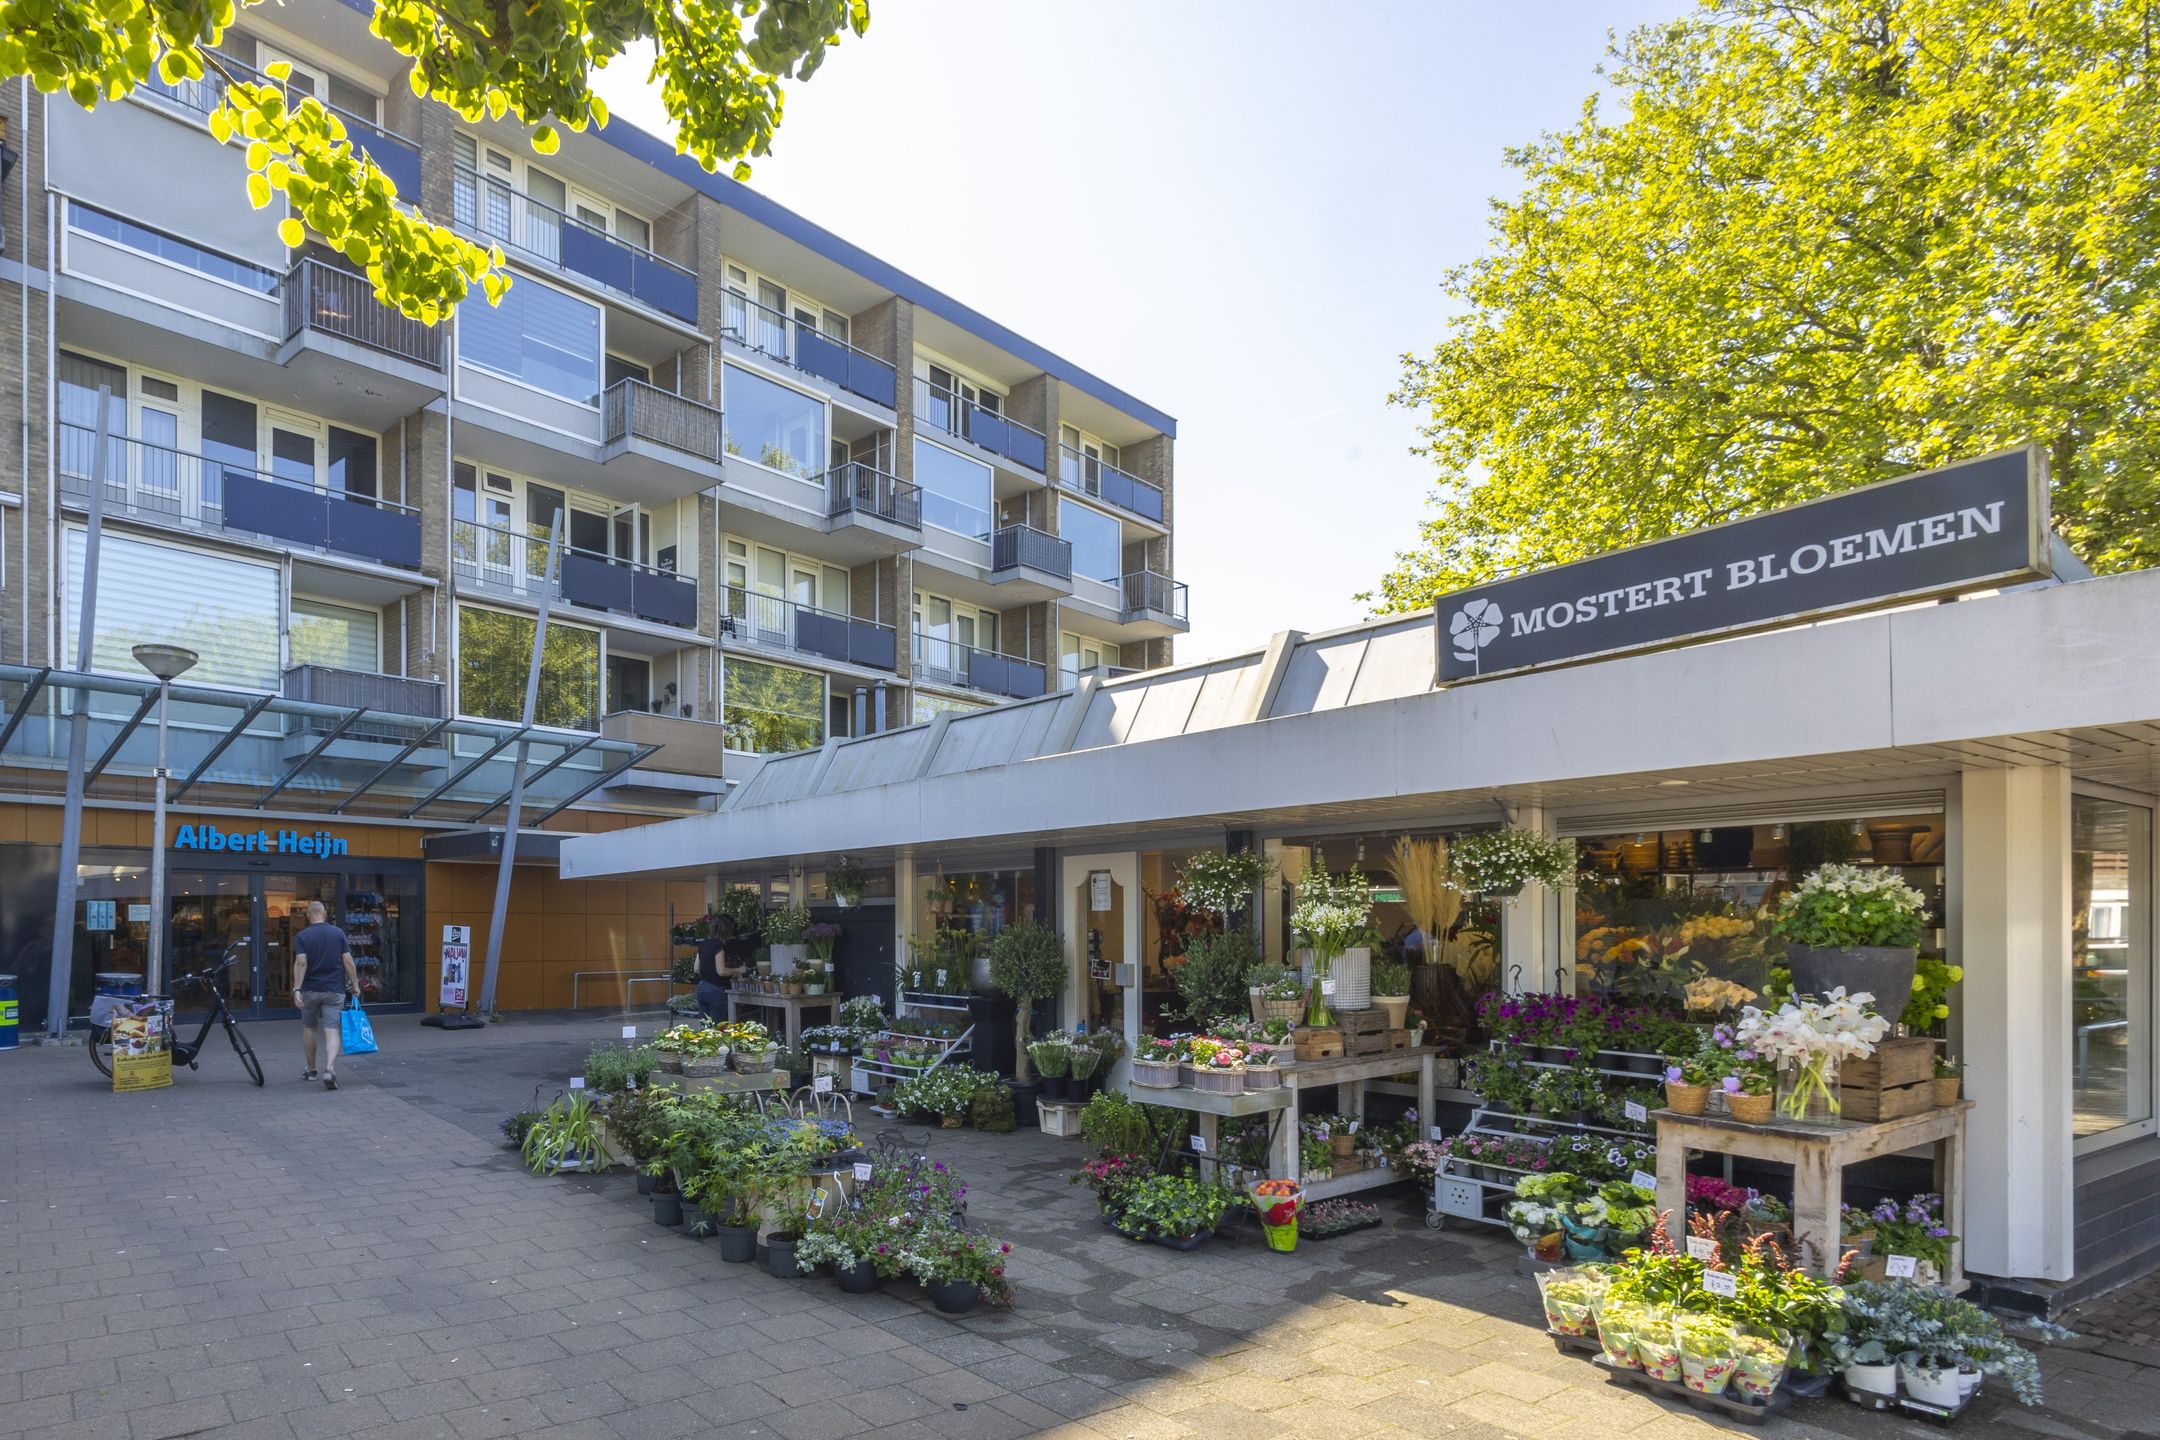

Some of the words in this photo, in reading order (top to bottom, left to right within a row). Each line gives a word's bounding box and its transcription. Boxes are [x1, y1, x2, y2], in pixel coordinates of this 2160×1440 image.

[1510, 568, 1713, 638] MOSTERT
[1726, 500, 2005, 591] BLOEMEN
[174, 824, 269, 852] Albert
[278, 830, 348, 860] Heijn
